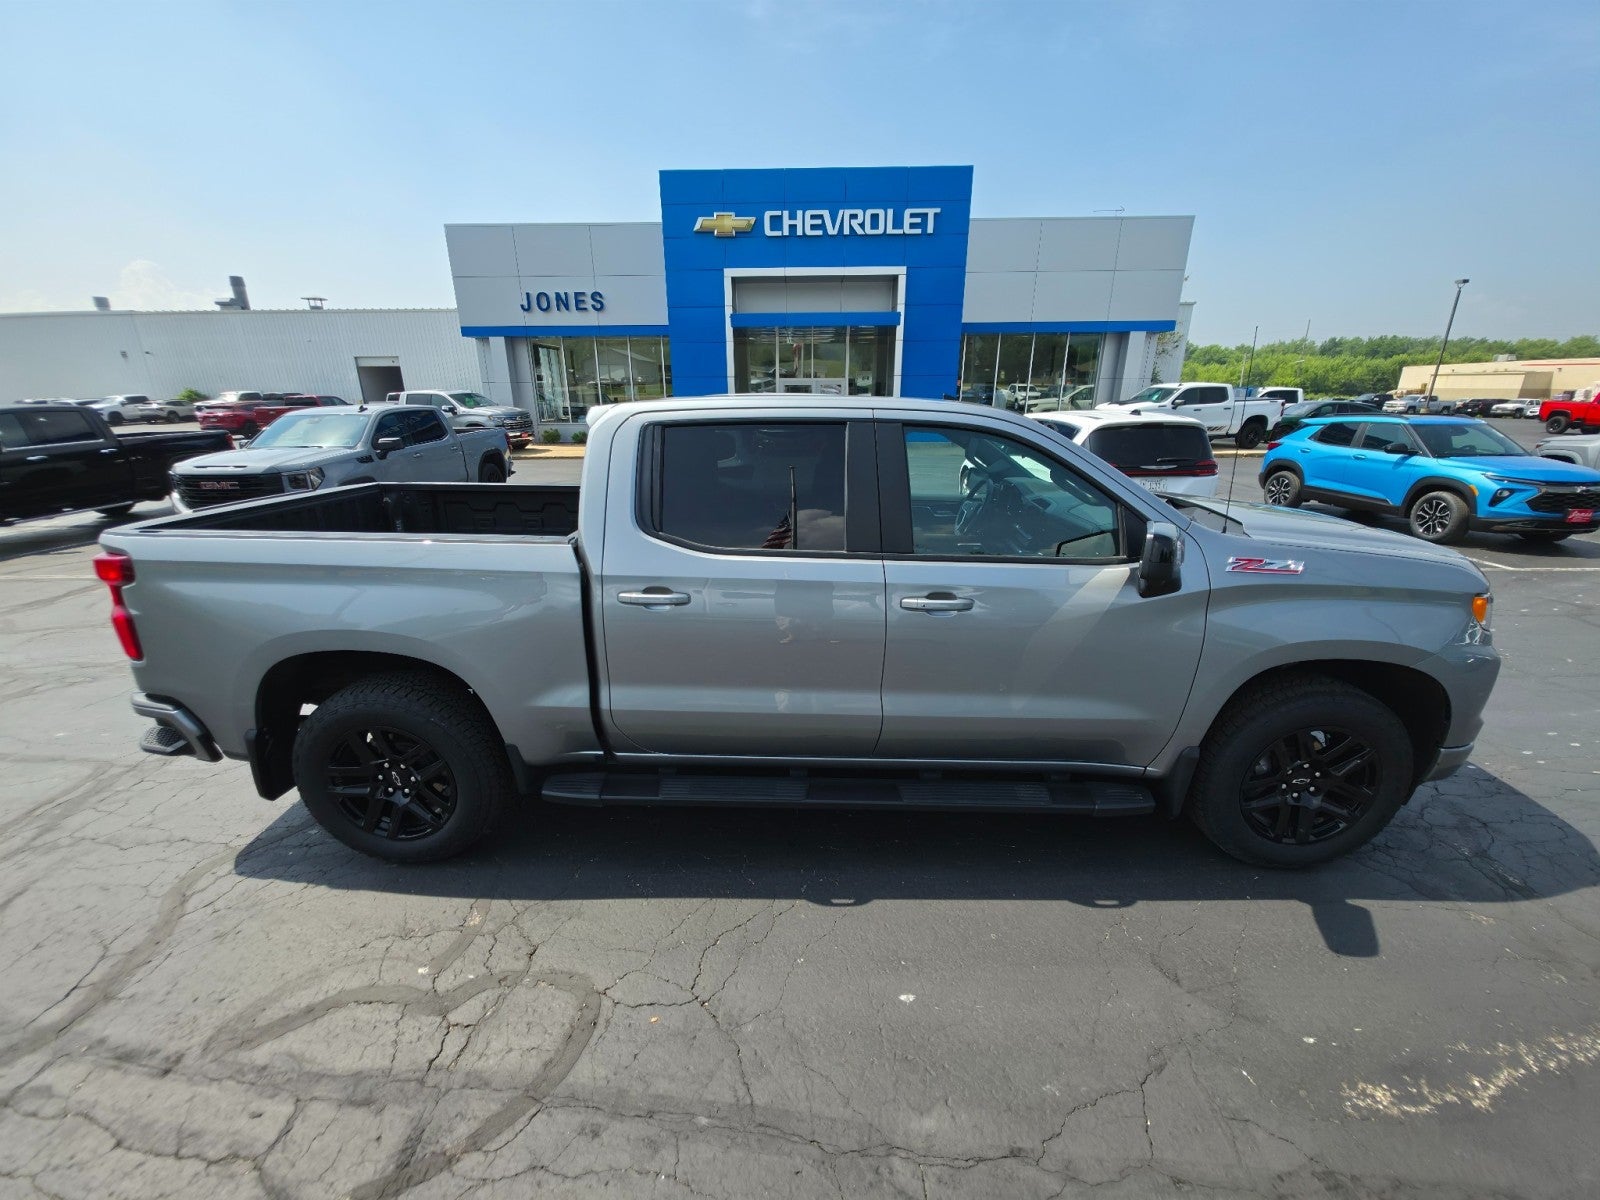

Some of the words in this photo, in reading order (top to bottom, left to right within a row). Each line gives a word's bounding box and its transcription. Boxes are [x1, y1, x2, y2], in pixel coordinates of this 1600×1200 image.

[763, 207, 942, 237] CHEVROLET
[520, 291, 605, 313] JONES
[200, 481, 240, 490] GMC
